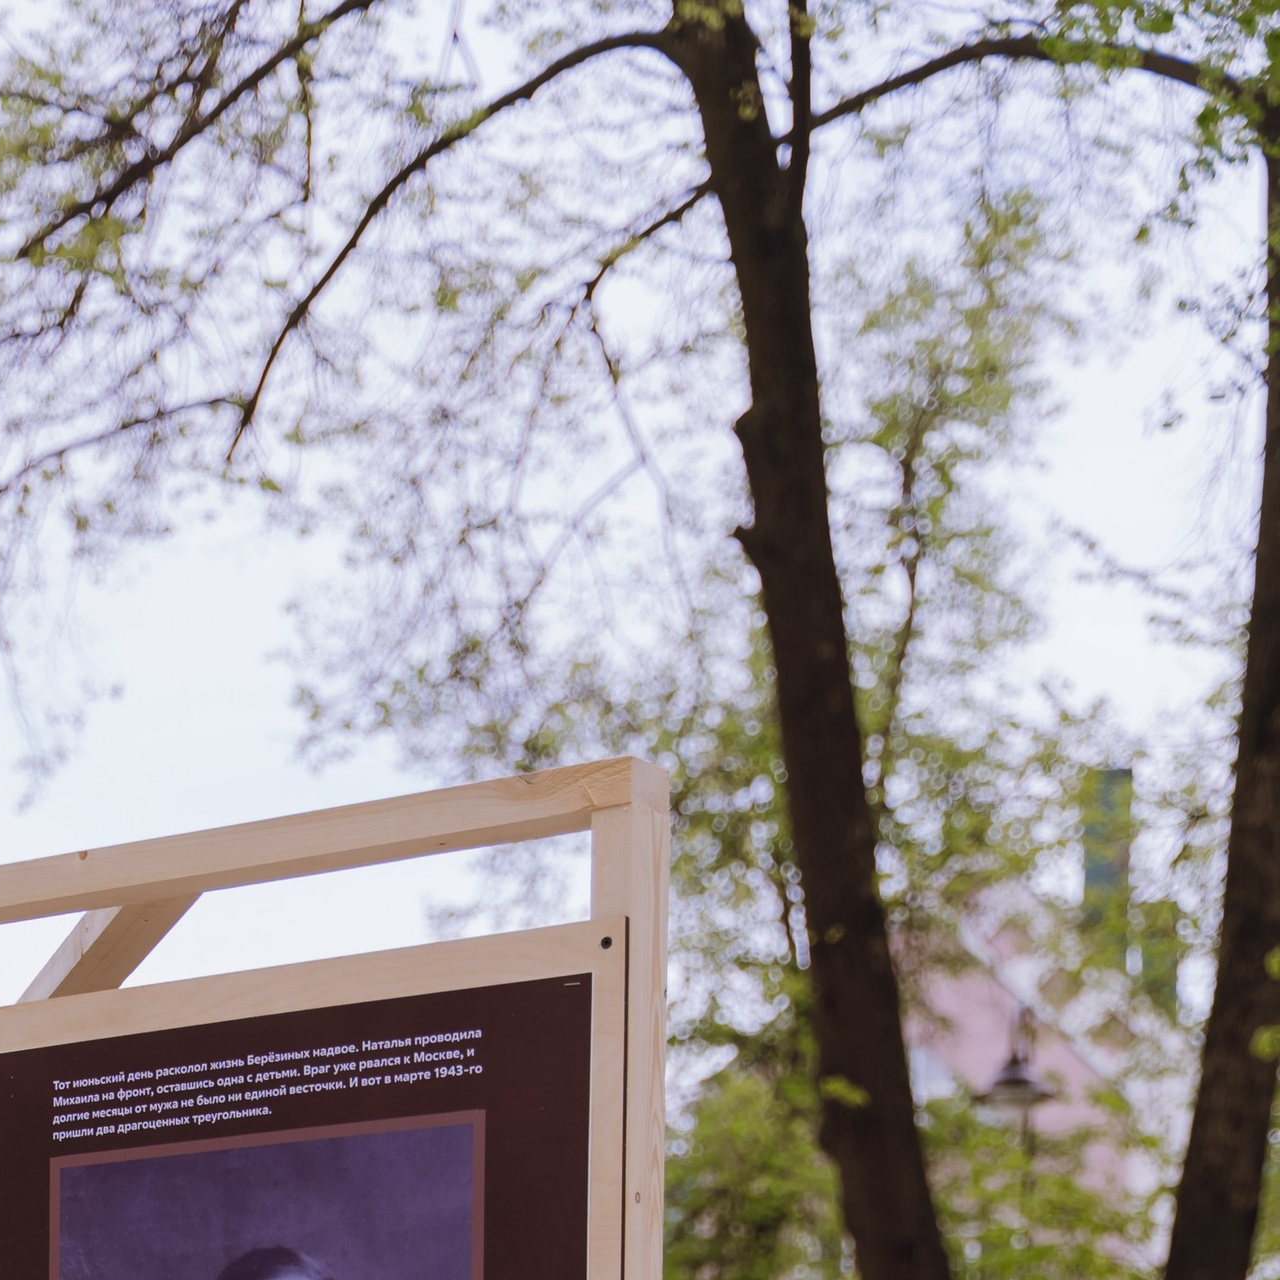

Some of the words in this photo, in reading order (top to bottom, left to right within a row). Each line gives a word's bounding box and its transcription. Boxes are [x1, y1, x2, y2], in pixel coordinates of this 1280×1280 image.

[52, 1079, 71, 1091] Тот
[72, 1070, 125, 1088] июньский
[126, 1070, 154, 1083] день
[155, 1062, 208, 1080] расколол
[209, 1058, 245, 1070] жизнь
[246, 1049, 310, 1066] Берёзиных
[312, 1044, 359, 1057] надвое.
[361, 1037, 412, 1051] Наталья
[413, 1029, 482, 1047] проводила
[52, 1093, 100, 1107] Михаила
[101, 1091, 115, 1101] на
[116, 1086, 154, 1101] фронт,
[155, 1079, 215, 1094] оставшись
[216, 1074, 244, 1087] одна
[246, 1073, 253, 1083] с
[254, 1068, 301, 1083] детьми.
[303, 1064, 331, 1078] Враг
[332, 1061, 357, 1075] уже
[358, 1056, 401, 1072] рвался
[403, 1055, 411, 1064] к
[413, 1049, 464, 1063] Москве,
[466, 1047, 475, 1057] и
[52, 1111, 90, 1125] долгие
[91, 1106, 133, 1119] месяцы
[134, 1104, 148, 1113] от
[149, 1100, 179, 1113] мужа
[180, 1098, 194, 1108] не
[195, 1094, 226, 1106] было
[227, 1092, 242, 1102] ни
[243, 1084, 287, 1101] единой
[288, 1080, 346, 1095] весточки.
[348, 1076, 358, 1088] И
[360, 1075, 382, 1087] вот
[383, 1074, 392, 1084] в
[393, 1070, 431, 1084] марте
[433, 1064, 483, 1078] 1943-го
[52, 1127, 94, 1142] пришли
[95, 1124, 115, 1136] два
[116, 1115, 190, 1134] драгоценных
[191, 1106, 272, 1125] треугольника.
